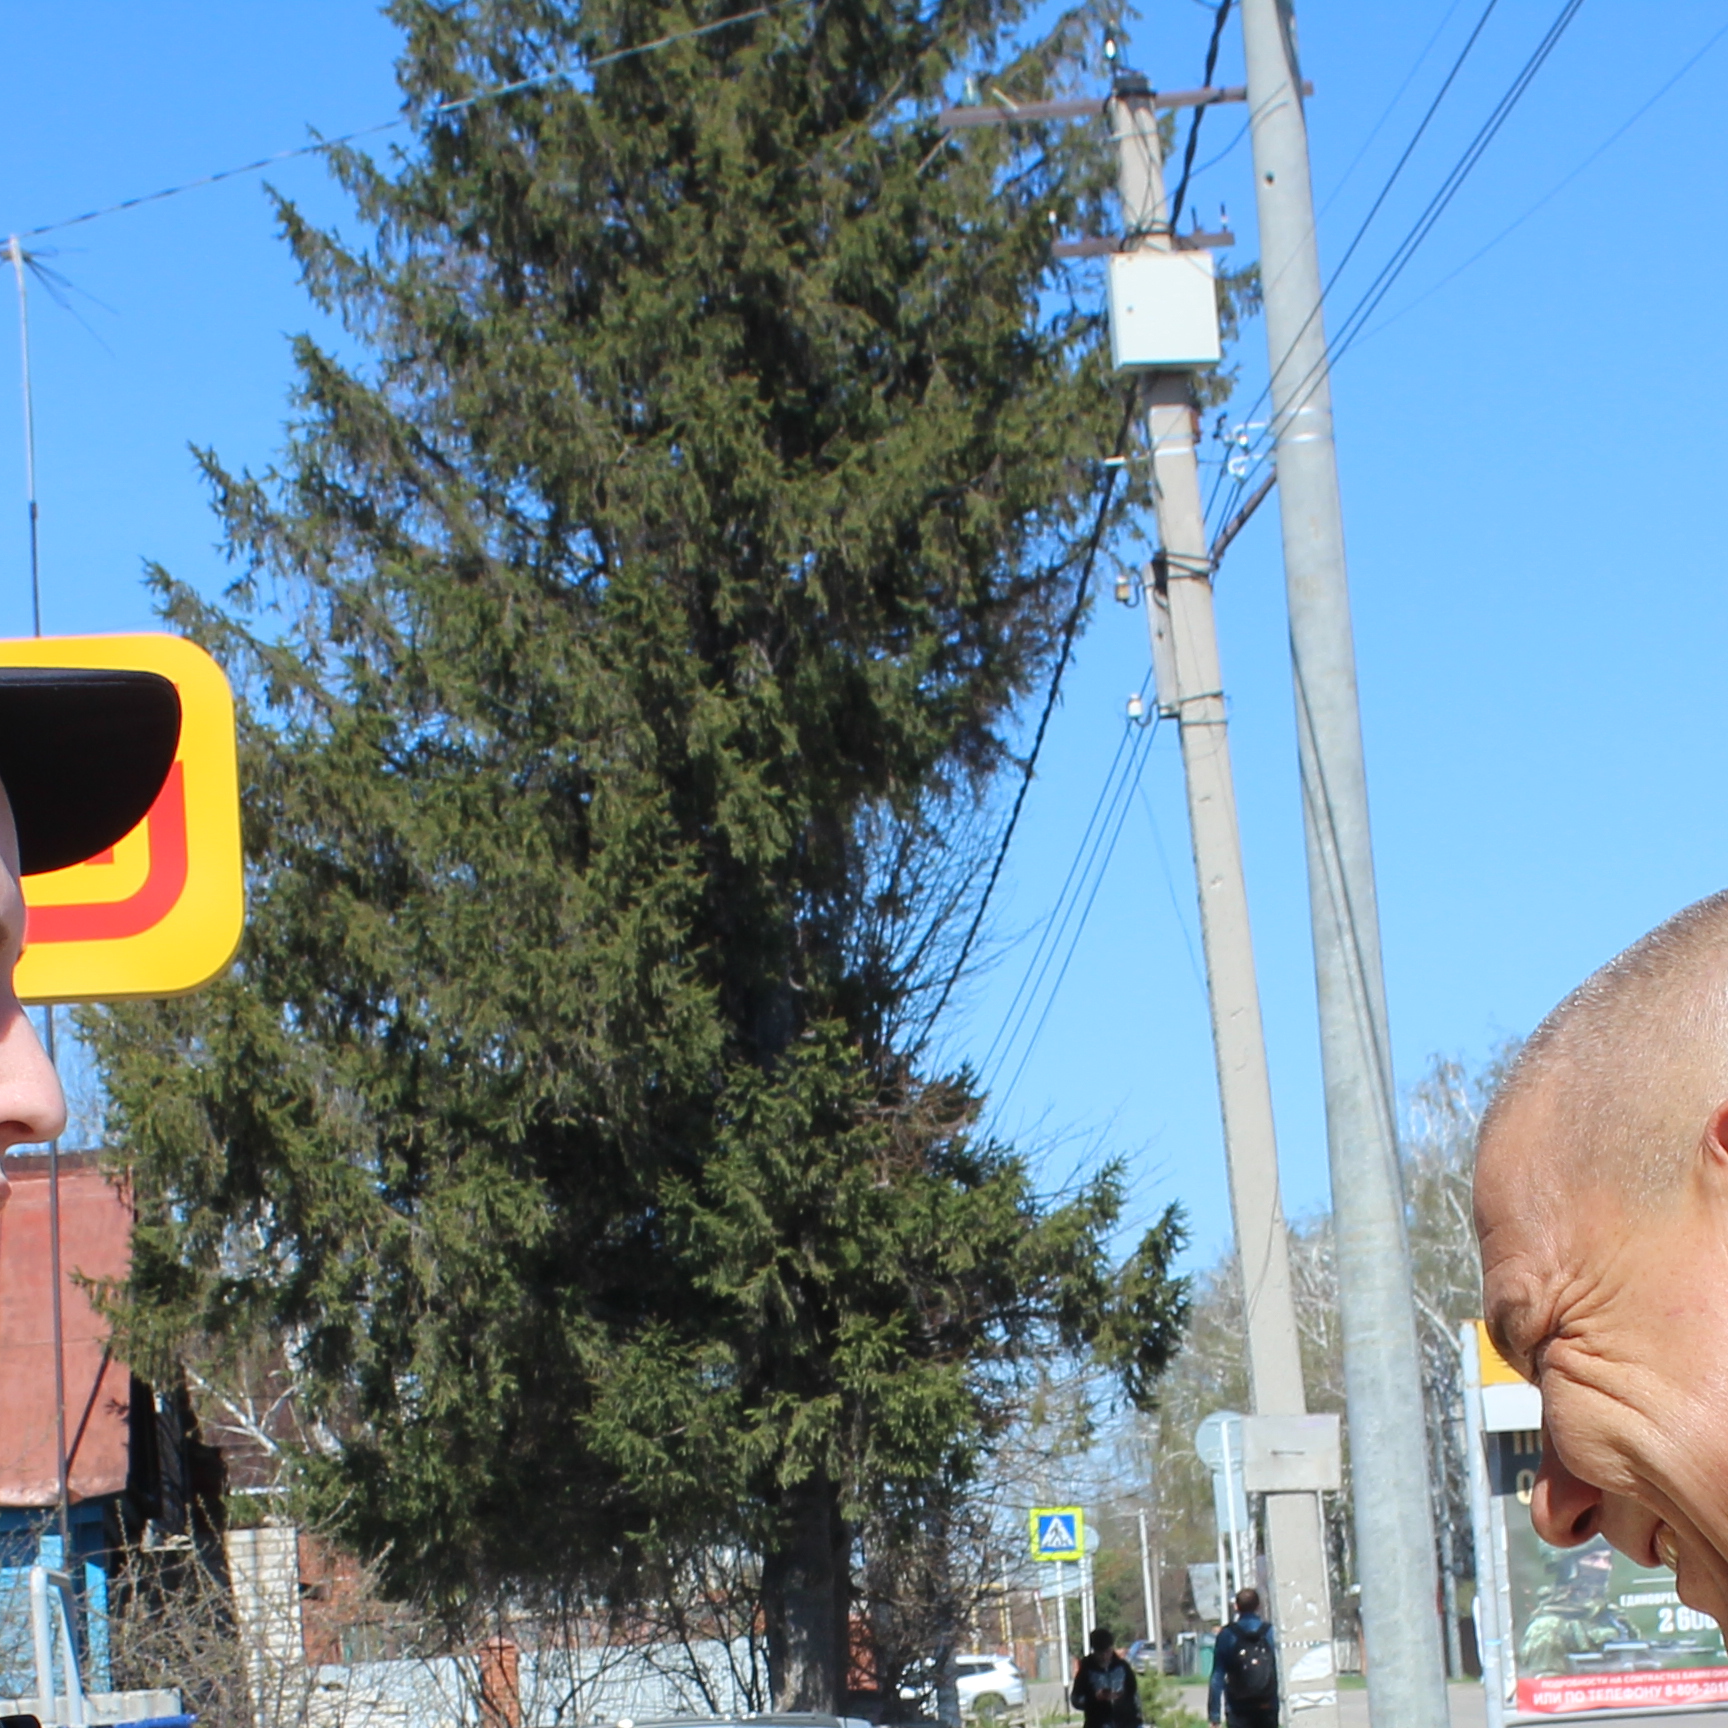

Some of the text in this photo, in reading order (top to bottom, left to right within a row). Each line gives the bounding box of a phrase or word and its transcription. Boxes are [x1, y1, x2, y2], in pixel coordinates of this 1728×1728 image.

[1533, 1691, 1562, 1705] ИЛИ
[1565, 1689, 1586, 1703] ПО
[1589, 1684, 1663, 1701] ТЕЛЕФОНУ
